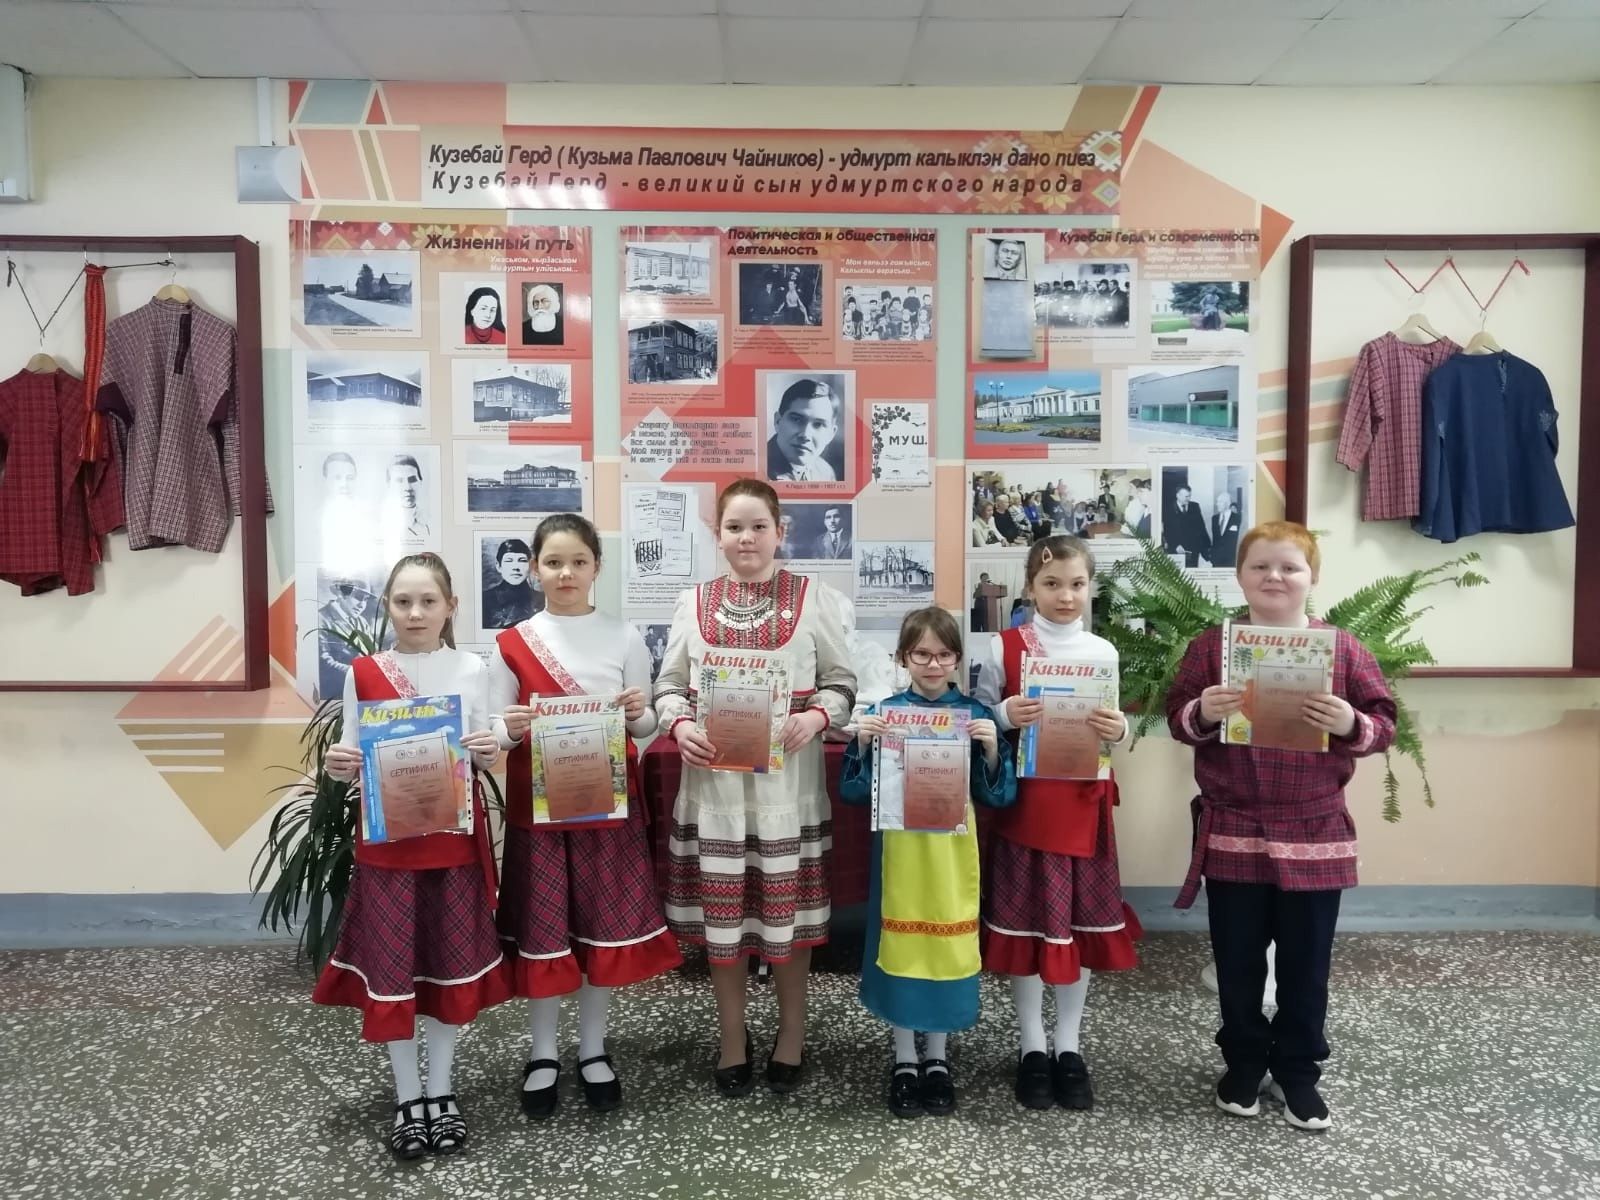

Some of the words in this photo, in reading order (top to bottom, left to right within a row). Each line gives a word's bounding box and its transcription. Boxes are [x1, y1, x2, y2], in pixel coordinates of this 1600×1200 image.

[429, 144, 503, 167] Кузебай
[508, 145, 552, 168] Герд
[638, 146, 726, 167] Павлович
[733, 146, 824, 170] Чайников)
[840, 149, 911, 171] удмурт
[916, 151, 1002, 168] калыклэн
[1007, 149, 1050, 168] дано
[1056, 152, 1096, 168] пиез
[638, 173, 745, 193] великий
[754, 176, 800, 193] сын
[810, 175, 984, 197] удмуртского
[993, 174, 1083, 195] народа
[425, 234, 530, 250] Жизненный
[535, 239, 575, 253] путь
[728, 228, 822, 241] Политическая
[825, 233, 833, 241] и
[837, 230, 935, 243] общественная
[1060, 231, 1112, 245] Кузебай
[1114, 231, 1145, 244] Герд
[1149, 234, 1156, 242] и
[1160, 233, 1260, 244] современность
[728, 245, 819, 257] деятельность
[1234, 630, 1310, 648] Кизили
[702, 651, 768, 669] Кизили
[1029, 661, 1095, 677] Кизили
[360, 705, 438, 724] Кизили
[534, 701, 602, 716] Кизили
[718, 709, 763, 720] СЕРТИФИКАТ
[886, 710, 950, 726] Кизили
[553, 752, 599, 766] СЕРТИФИКАТ
[390, 761, 440, 777] СЕРТИФИКАТ
[914, 767, 958, 776] СЕРТИФИКАТ
